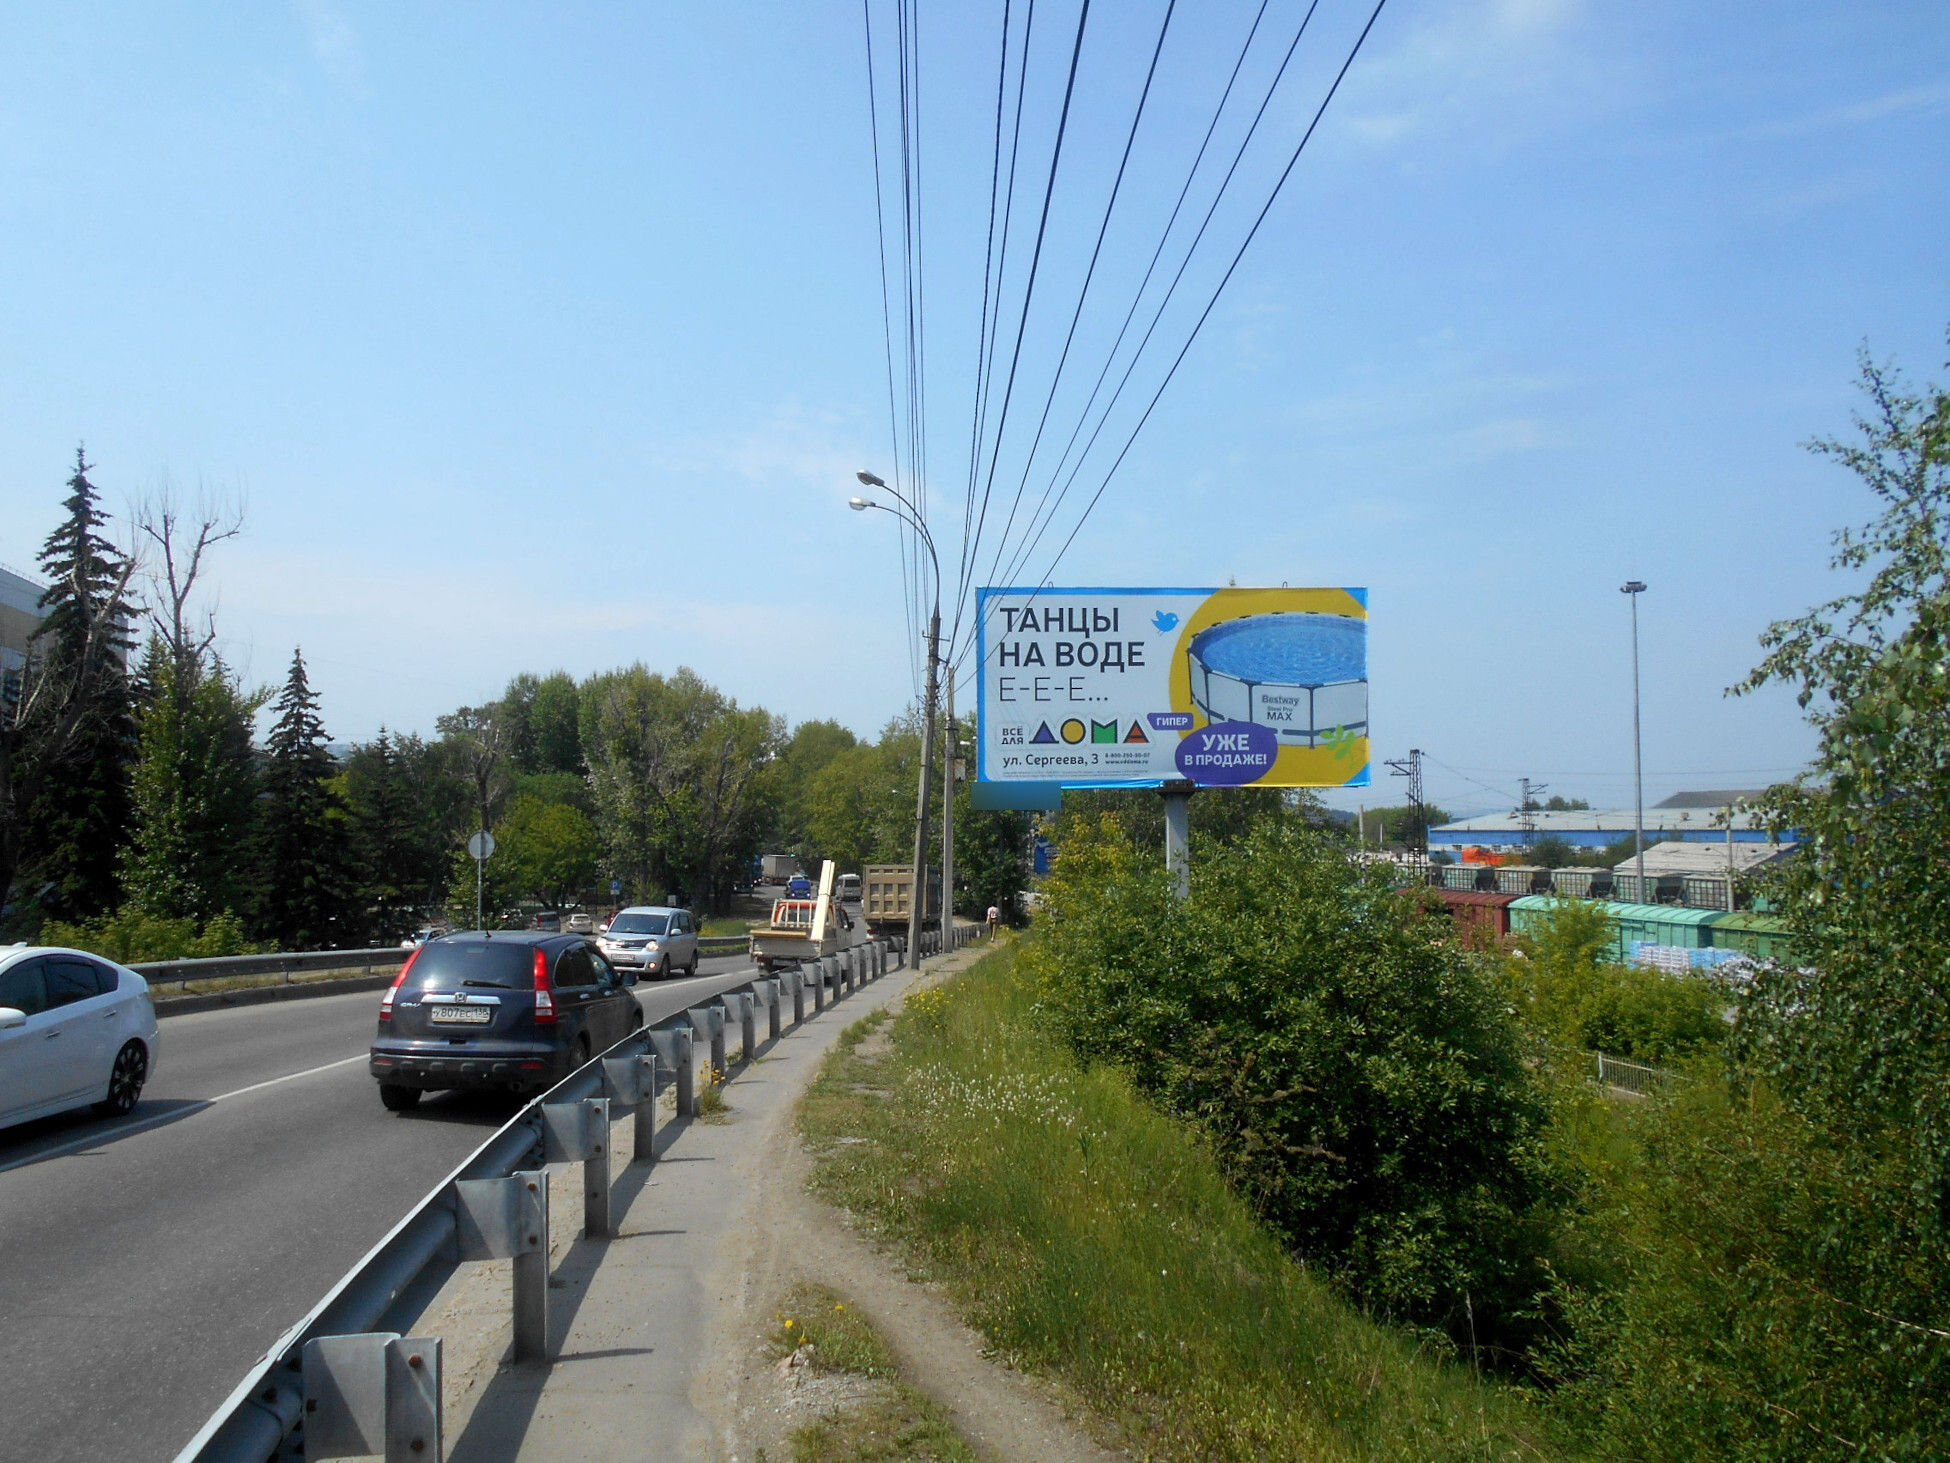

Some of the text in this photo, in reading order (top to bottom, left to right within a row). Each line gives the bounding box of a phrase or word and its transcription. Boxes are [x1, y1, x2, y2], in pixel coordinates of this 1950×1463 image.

[1000, 607, 1119, 638] ТАНЦЫ
[1000, 641, 1145, 673] НА ВОДЕ
[1262, 694, 1299, 706] Bestway
[1156, 717, 1188, 726] ГИПЕР
[1267, 711, 1292, 721] MAX
[1002, 725, 1024, 736] ВСЁ
[1028, 718, 1150, 745] ДОМА
[1001, 736, 1024, 745] ДЛЯ
[1202, 733, 1250, 751] УЖЕ
[1003, 753, 1099, 768] ул. Сергеева, 3
[1184, 753, 1267, 767] В ПРОДАЖЕ!
